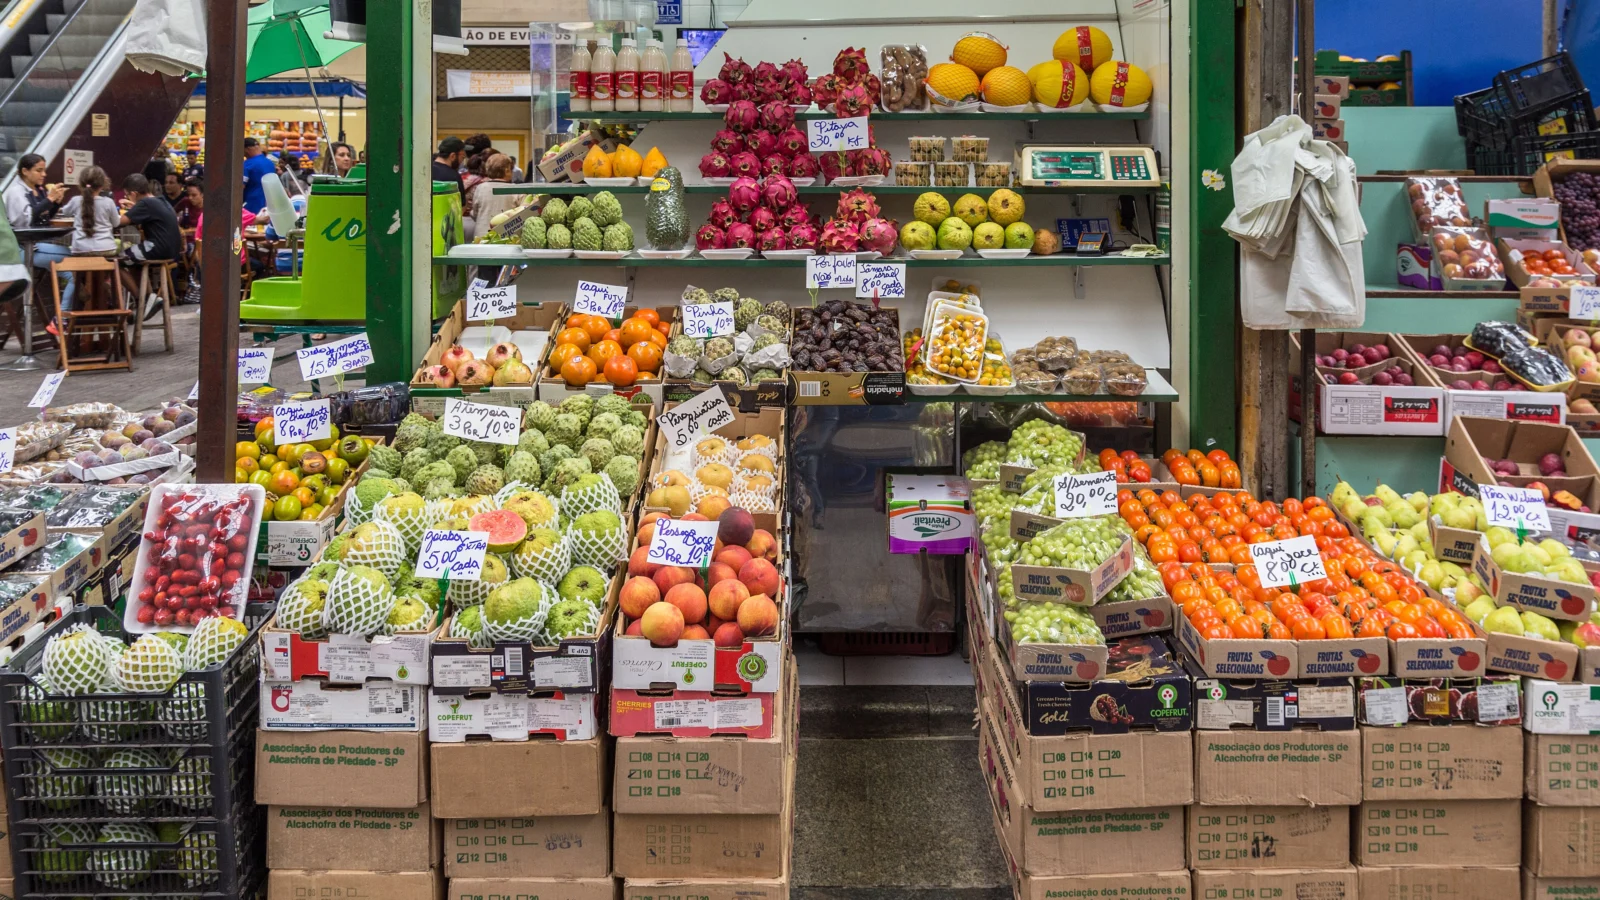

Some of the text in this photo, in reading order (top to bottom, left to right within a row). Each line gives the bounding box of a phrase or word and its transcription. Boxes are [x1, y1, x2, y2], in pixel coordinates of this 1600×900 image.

[466, 30, 485, 41] ÃO
[489, 31, 506, 41] DE
[814, 119, 860, 134] Pitaya
[556, 150, 576, 166] FRUTAS
[503, 215, 523, 231] FRUTAS
[832, 256, 856, 274] favor
[471, 287, 509, 302] Romã
[1531, 295, 1552, 303] FRUTAS
[469, 299, 503, 320] 10,00
[576, 295, 590, 311] 3
[1524, 302, 1560, 311] SELECIONADAS
[685, 305, 729, 319] Pinha
[684, 319, 697, 335] 3
[756, 391, 780, 401] Gold
[867, 386, 904, 396] mehadrin
[1394, 412, 1429, 422] Ameixas
[279, 420, 288, 437] 8
[449, 415, 516, 441] 3 10,00
[675, 408, 731, 446] 5,00 cada
[1060, 487, 1105, 512] 20,00
[1489, 500, 1526, 523] 12,00
[914, 516, 951, 526] Previtali
[1027, 520, 1048, 530] FRUTAS
[287, 536, 318, 544] COPEFRUT
[648, 538, 667, 559] 3
[1442, 547, 1474, 560] SELECION
[64, 558, 82, 578] FRUTAS
[423, 550, 480, 573] 5,00 cada
[1265, 559, 1298, 582] 8,00
[1028, 574, 1051, 585] FRUTAS
[1019, 583, 1063, 598] SELECIONADAS
[1519, 584, 1548, 598] FRUTAS
[2, 605, 22, 629] FRUTAS
[1105, 612, 1131, 625] FRUTAS
[1099, 619, 1142, 636] ELECIONADAS
[1035, 651, 1063, 665] FRUTAS
[1226, 651, 1254, 663] FRUTAS
[1317, 650, 1344, 662] FRUTAS
[1416, 648, 1444, 660] FRUTAS
[1503, 647, 1532, 662] FRUTAS
[622, 659, 663, 677] Cherries
[670, 660, 708, 669] COPEFRUT
[1024, 663, 1073, 677] SELECIONADAS
[1215, 662, 1264, 675] SELECIONADAS
[1305, 661, 1355, 674] SELECIONADAS
[1405, 659, 1454, 671] SELECIONADAS
[1490, 657, 1540, 674] SELECIONADAS
[616, 700, 653, 709] CHERRIES
[1425, 693, 1441, 703] Rio
[437, 713, 473, 722] COPEFRUT
[1039, 710, 1070, 725] Gold
[1149, 708, 1187, 718] COPEFRUT
[1534, 710, 1566, 719] COPEFRUT
[262, 742, 406, 757] Associação dos Produtores de
[1207, 742, 1349, 754] Associação dos Produtores de
[1384, 743, 1450, 753] 08 14 20
[269, 754, 399, 767] Alcachofra de Piedade SP
[642, 752, 710, 761] 08 14 20
[1055, 750, 1121, 761] 08 14 20
[1214, 753, 1342, 763] Alcachofra de Piedade SP
[1385, 761, 1422, 770] 10 16
[643, 769, 681, 778] 10 16
[1056, 769, 1094, 779] 10 16
[1384, 778, 1422, 787] 12 18
[642, 786, 681, 795] 12 18
[1056, 787, 1095, 797] 12 18
[279, 809, 420, 821] Associação dos Produtores de
[1030, 811, 1170, 827] Associação dos Produtores de
[286, 819, 414, 830] Alcachofra de Piedade SP
[1036, 822, 1164, 837] Alcachofra de Piedade SP
[1045, 885, 1188, 898] Associação dos Produtores de
